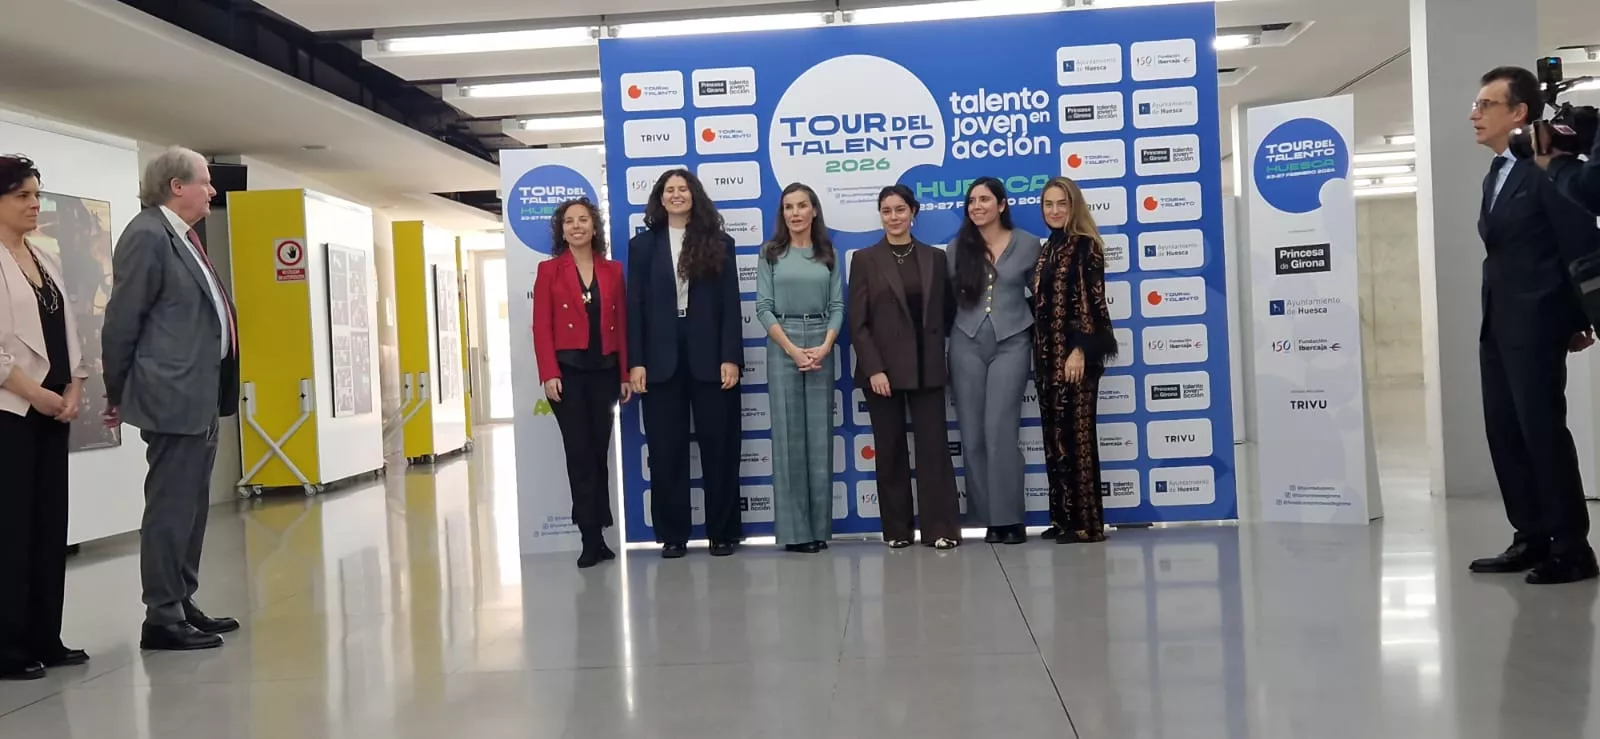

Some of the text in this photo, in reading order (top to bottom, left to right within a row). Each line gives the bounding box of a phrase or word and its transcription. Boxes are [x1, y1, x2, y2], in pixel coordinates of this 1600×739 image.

[950, 87, 1050, 114] talento
[780, 113, 932, 136] TOUR DEL
[952, 110, 1050, 142] joven en
[640, 134, 670, 142] TRIVU
[781, 134, 934, 156] TALENTO
[952, 131, 1051, 160] acción
[1266, 139, 1335, 154] TOUR DEL
[1266, 148, 1335, 162] TALENTO
[825, 157, 890, 173] 2026
[1266, 159, 1335, 172] HUESCA
[714, 177, 744, 185] TRIVU
[518, 186, 566, 196] TOUR
[520, 196, 582, 204] TALENT
[1280, 248, 1324, 259] Princesa
[1291, 259, 1324, 269] Girona
[1287, 296, 1340, 307] Ayuntamiento
[1272, 340, 1291, 352] 150
[1290, 400, 1327, 409] TRIVU
[1165, 435, 1195, 443] TRIVU
